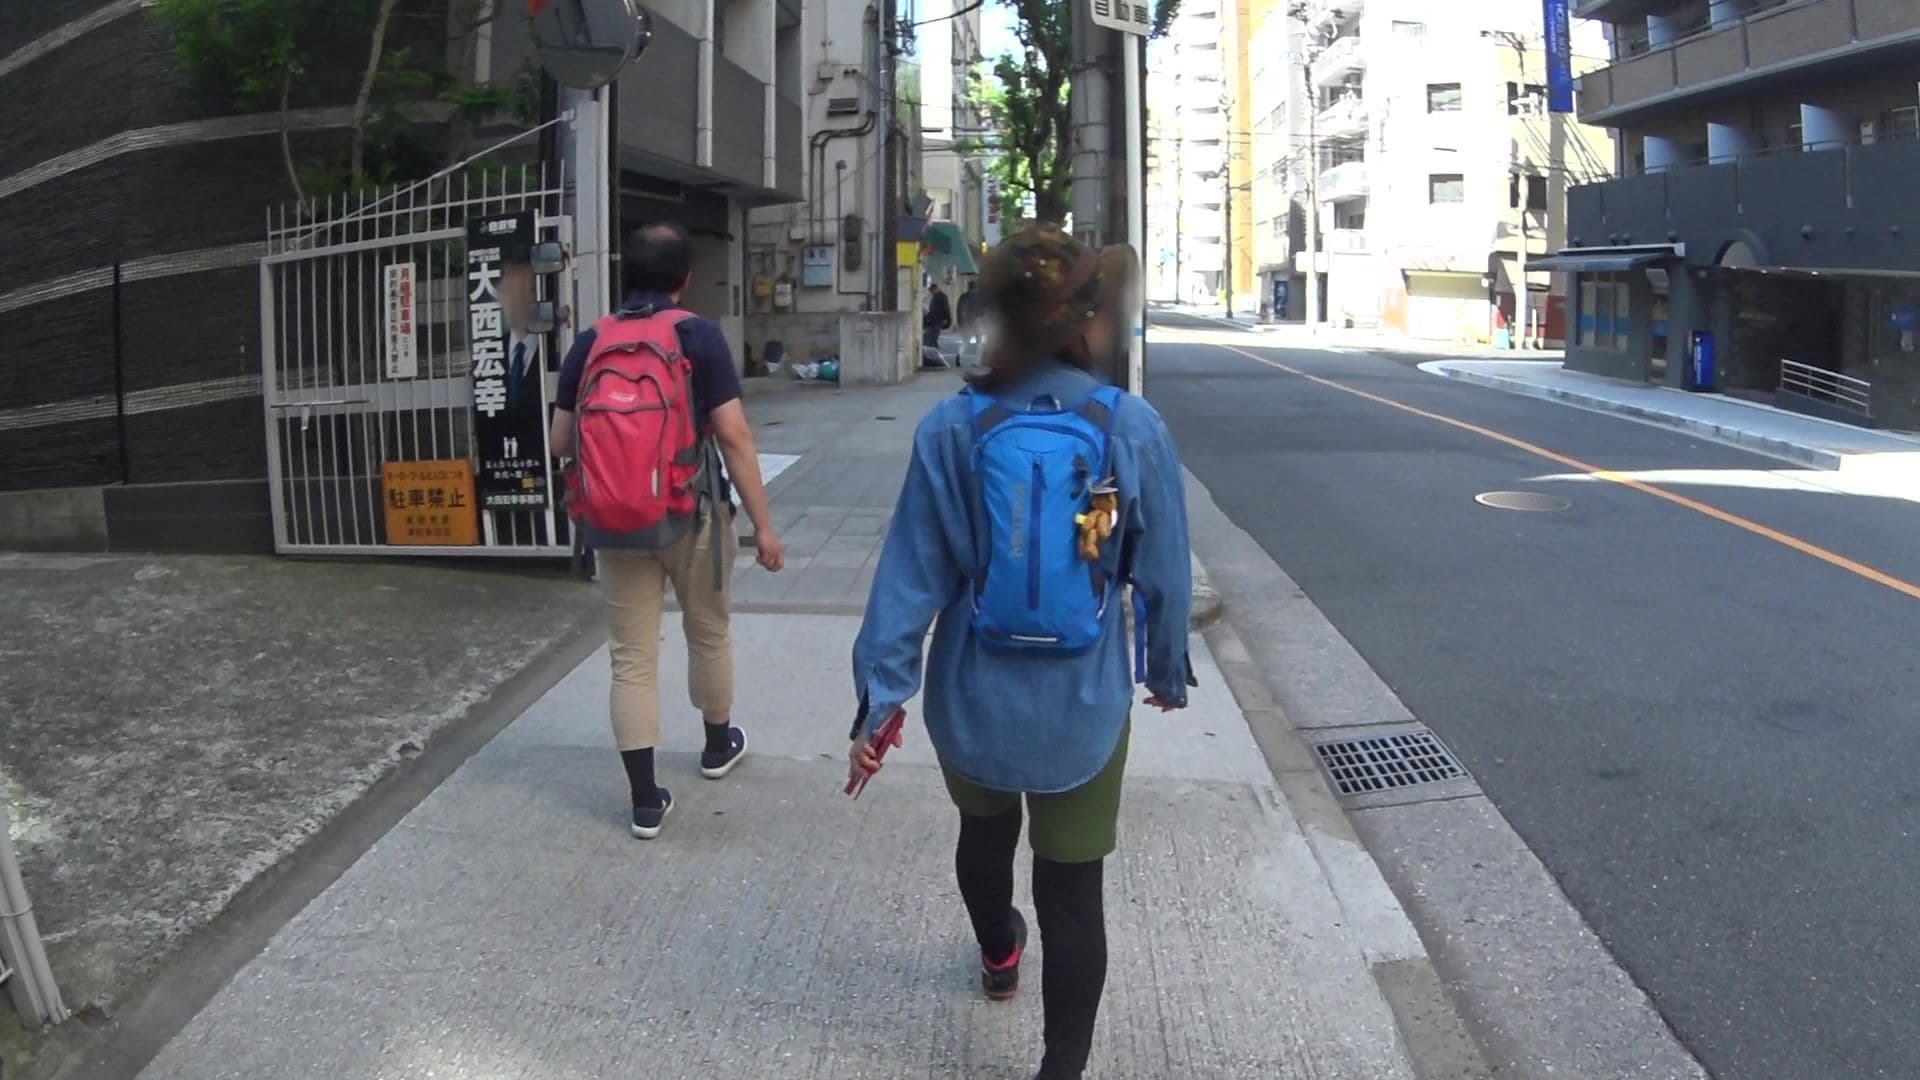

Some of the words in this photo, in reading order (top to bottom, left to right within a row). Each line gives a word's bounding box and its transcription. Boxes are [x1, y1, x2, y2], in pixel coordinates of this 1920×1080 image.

[1095, 0, 1148, 24] 自動車
[468, 262, 507, 418] 大西宏幸
[389, 487, 466, 509] 駐車禁止
